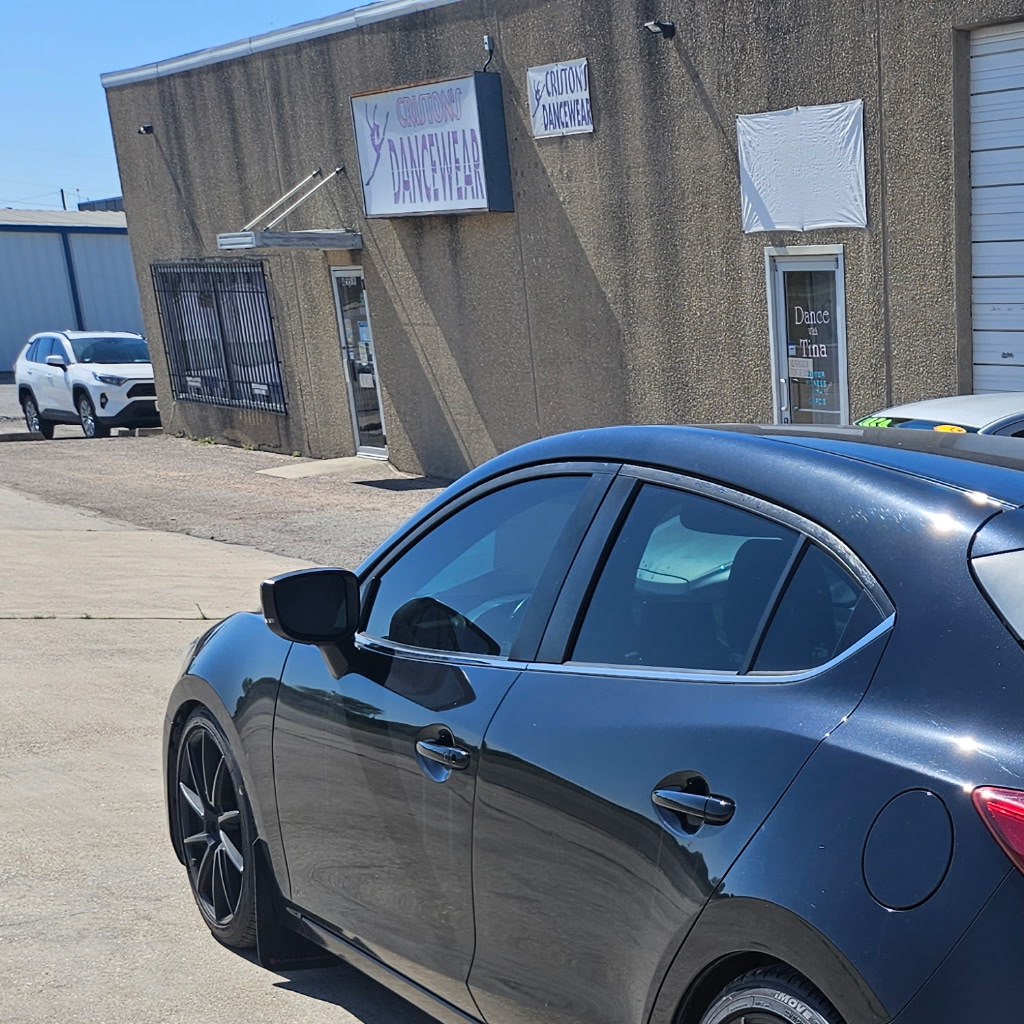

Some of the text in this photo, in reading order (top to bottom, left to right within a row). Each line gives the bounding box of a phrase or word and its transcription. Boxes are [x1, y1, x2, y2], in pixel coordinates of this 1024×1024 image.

[542, 97, 593, 131] DANCEWEAR
[387, 128, 485, 205] DANCEWEAR
[794, 306, 830, 325] Dance
[800, 338, 828, 358] Tina
